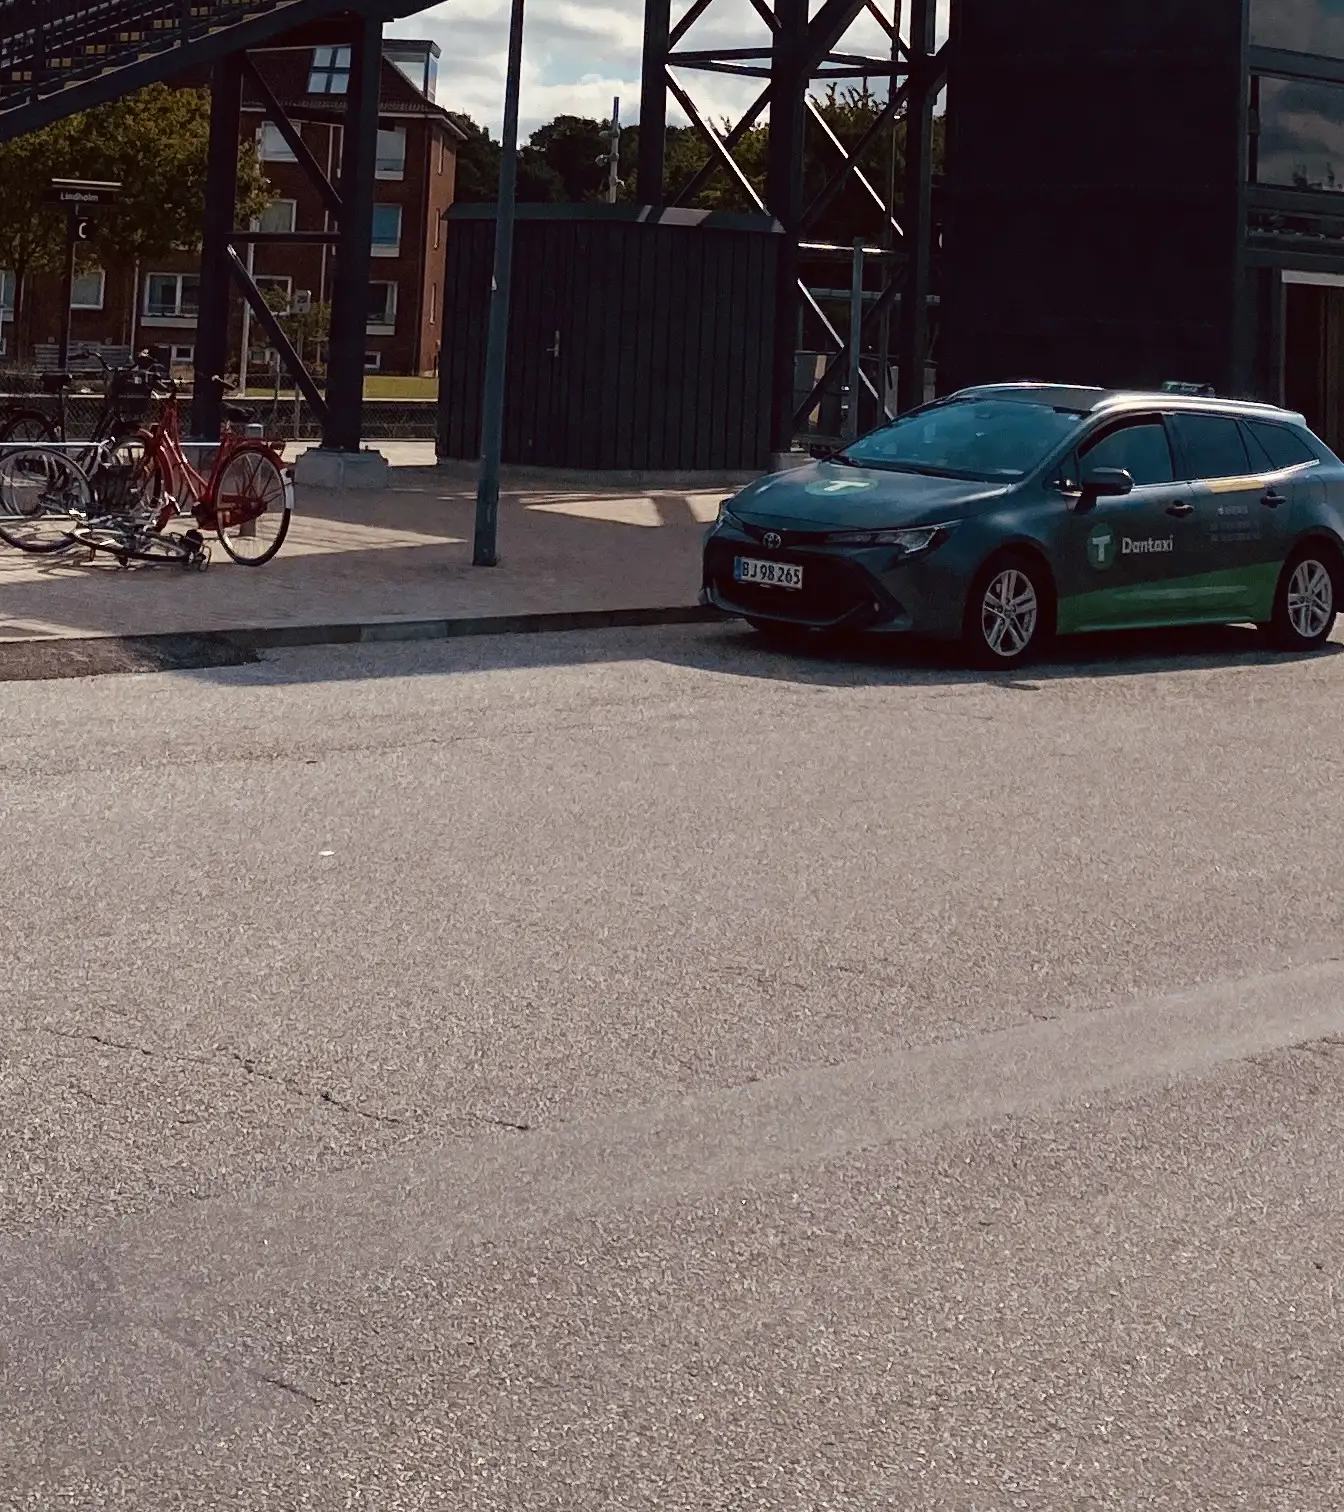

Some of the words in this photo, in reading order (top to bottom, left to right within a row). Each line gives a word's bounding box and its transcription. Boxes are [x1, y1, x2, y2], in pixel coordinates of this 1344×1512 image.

[60, 191, 99, 202] Lindholm
[78, 222, 87, 239] C
[1092, 535, 1111, 562] T
[1121, 533, 1174, 554] Dantaxi
[742, 561, 757, 578] BJ
[760, 564, 775, 581] 98
[778, 567, 801, 585] 265
